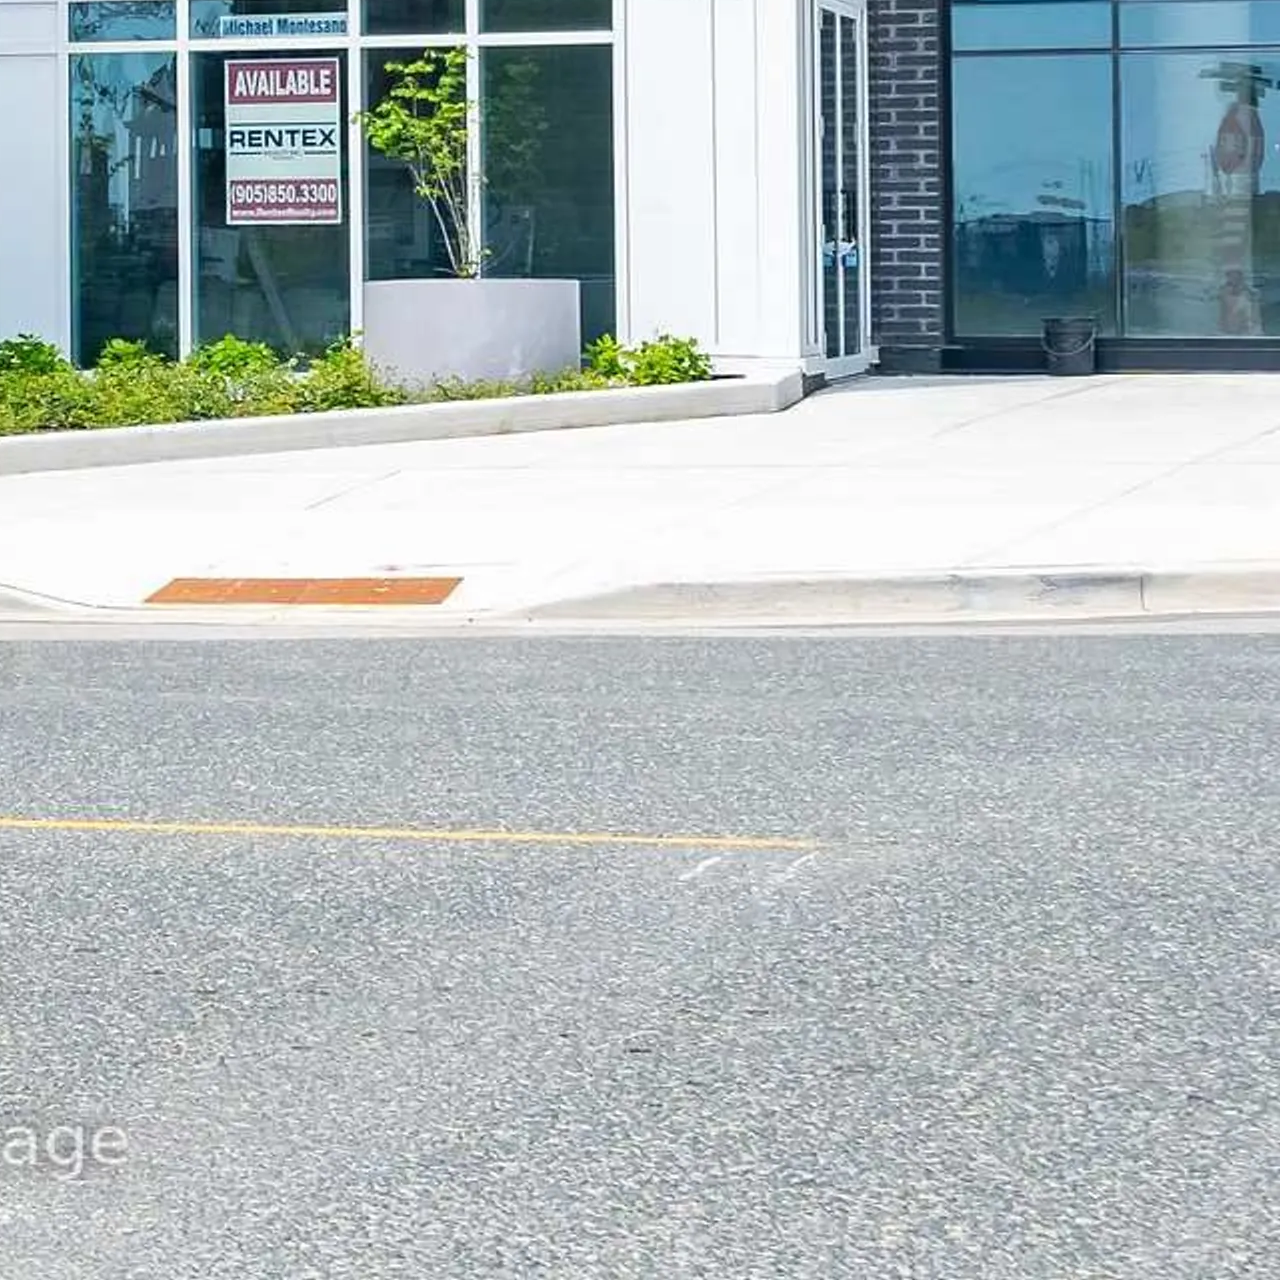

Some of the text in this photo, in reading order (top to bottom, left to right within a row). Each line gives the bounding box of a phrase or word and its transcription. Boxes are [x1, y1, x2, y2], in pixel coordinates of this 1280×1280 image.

[234, 69, 331, 96] AVAILABLE
[229, 128, 336, 148] RENTEX
[232, 183, 336, 204] (905)850.3300
